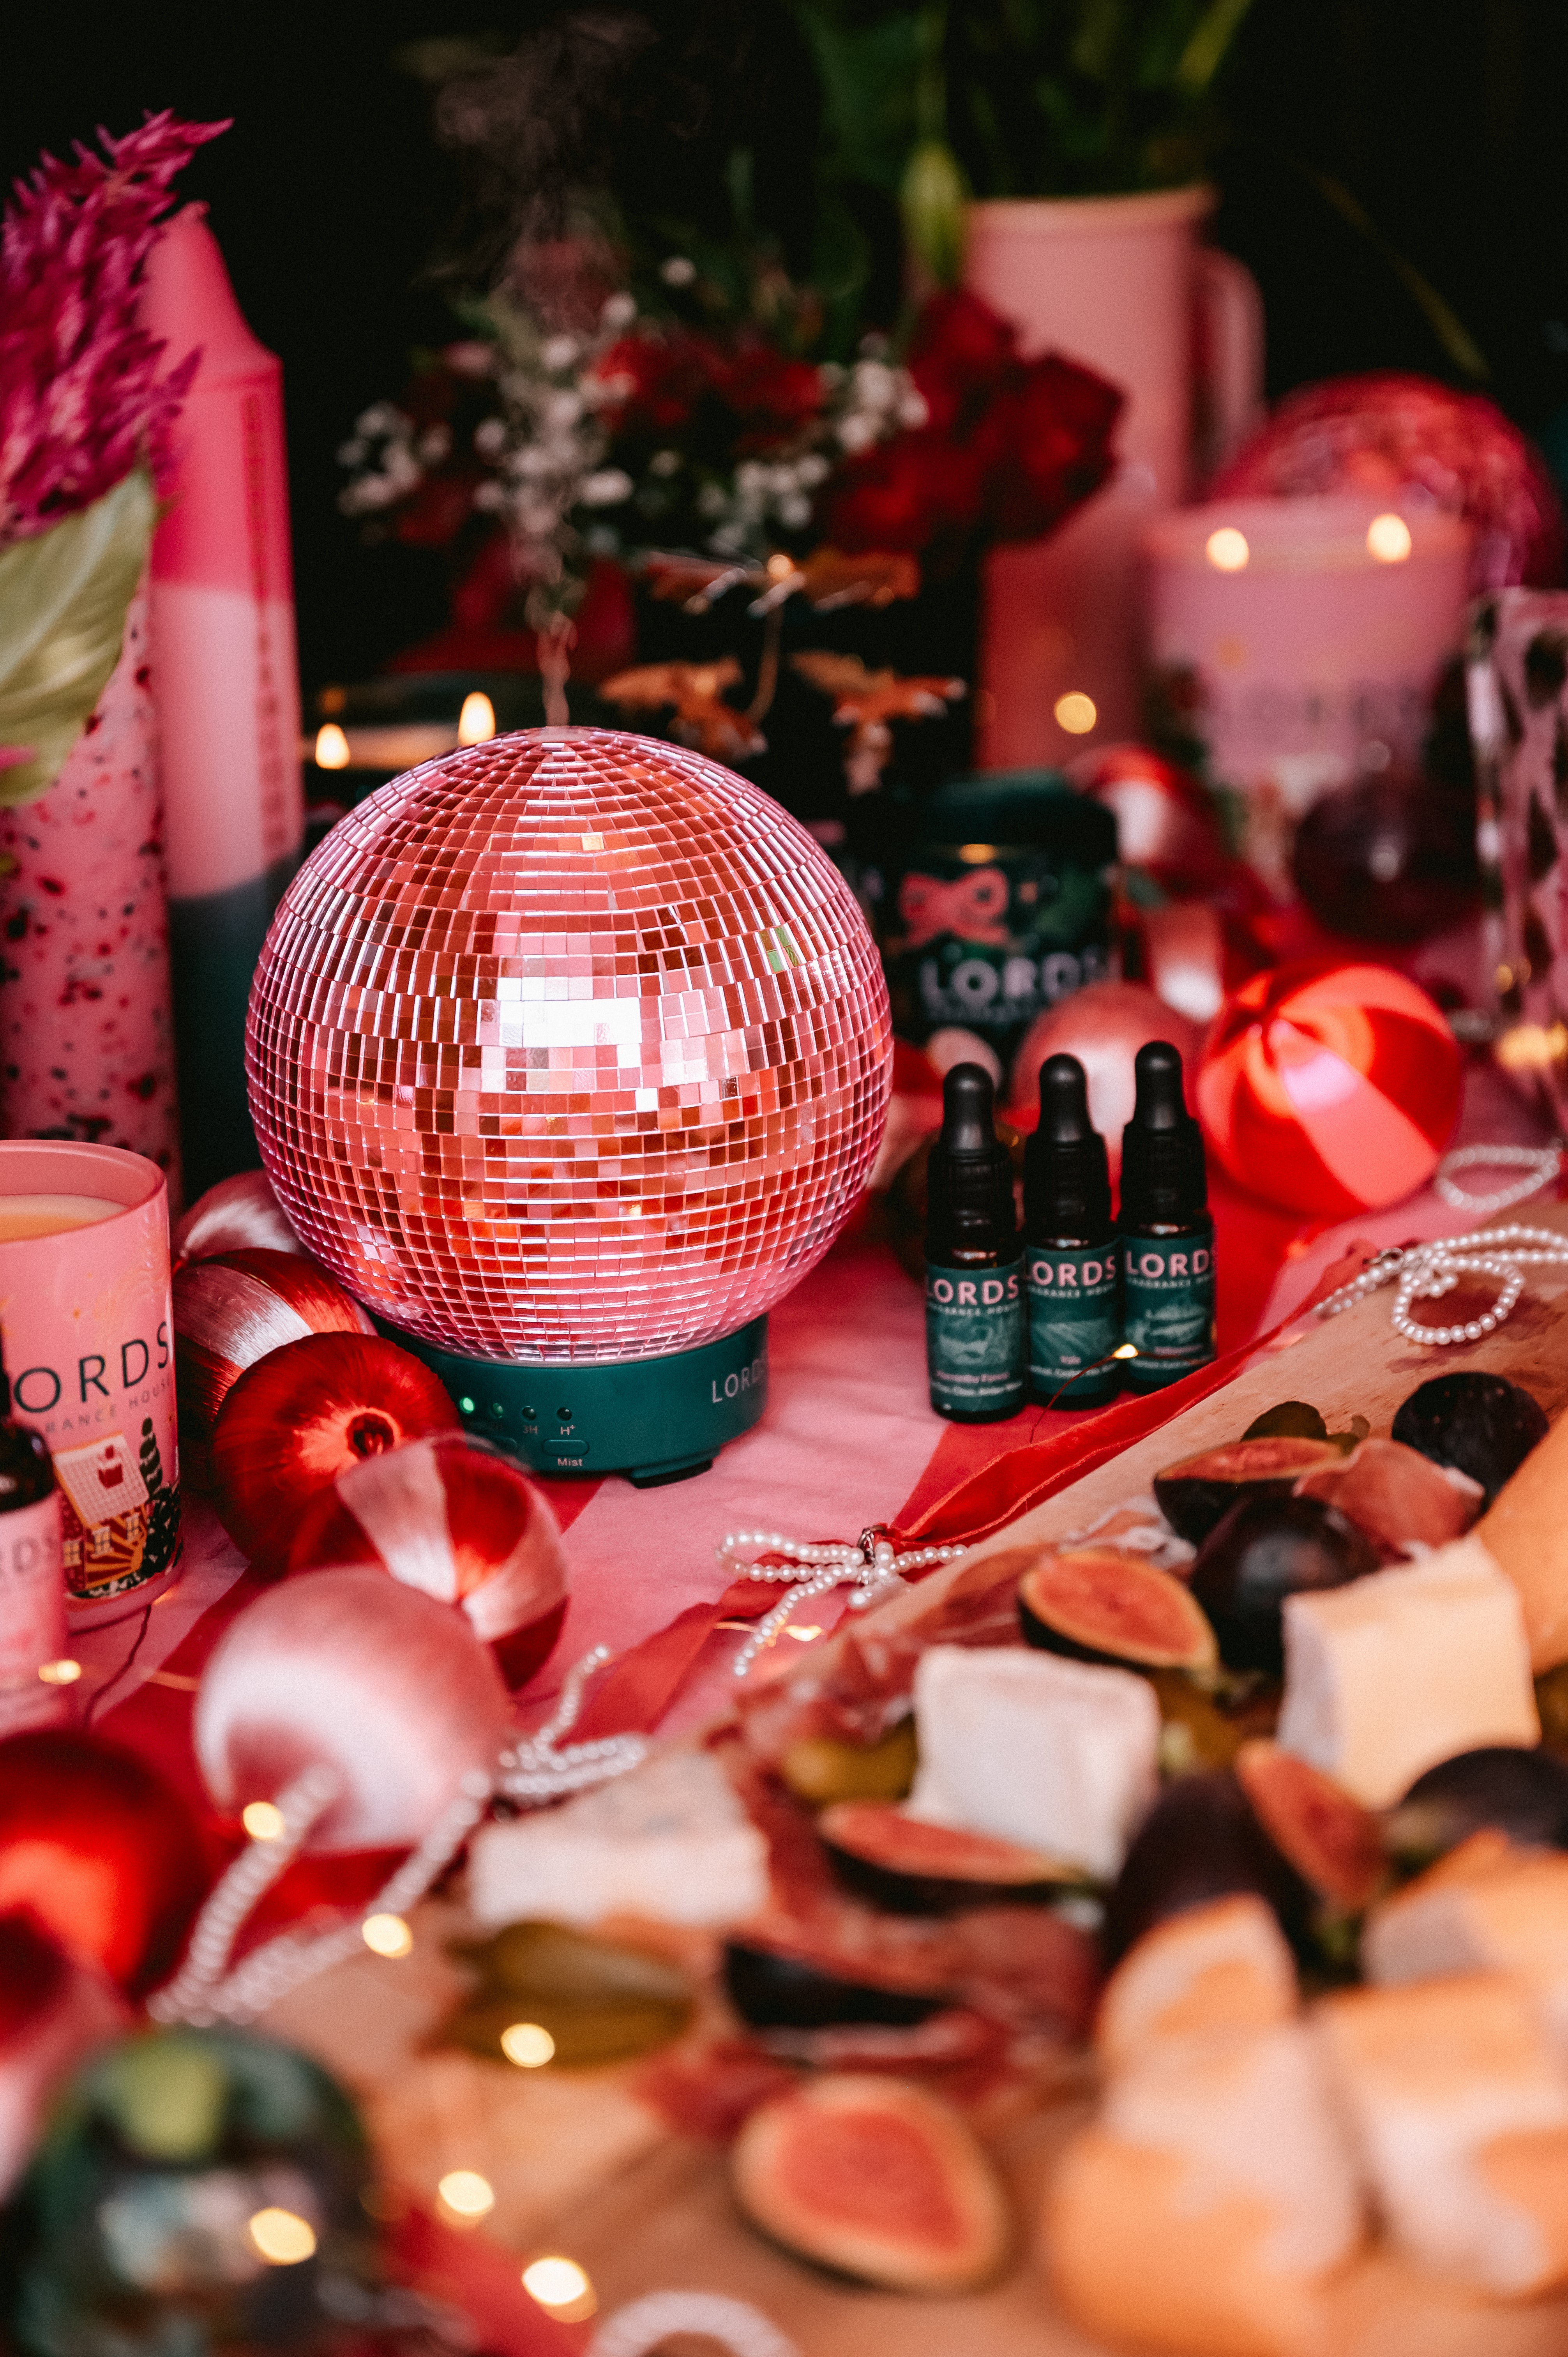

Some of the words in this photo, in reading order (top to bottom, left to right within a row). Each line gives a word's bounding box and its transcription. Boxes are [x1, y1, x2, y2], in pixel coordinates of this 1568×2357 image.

[1126, 1249, 1210, 1278] LORD
[13, 1321, 168, 1413] ORDS
[712, 1359, 766, 1403] LORD
[523, 1425, 538, 1435] 3H
[557, 1458, 583, 1466] Mist
